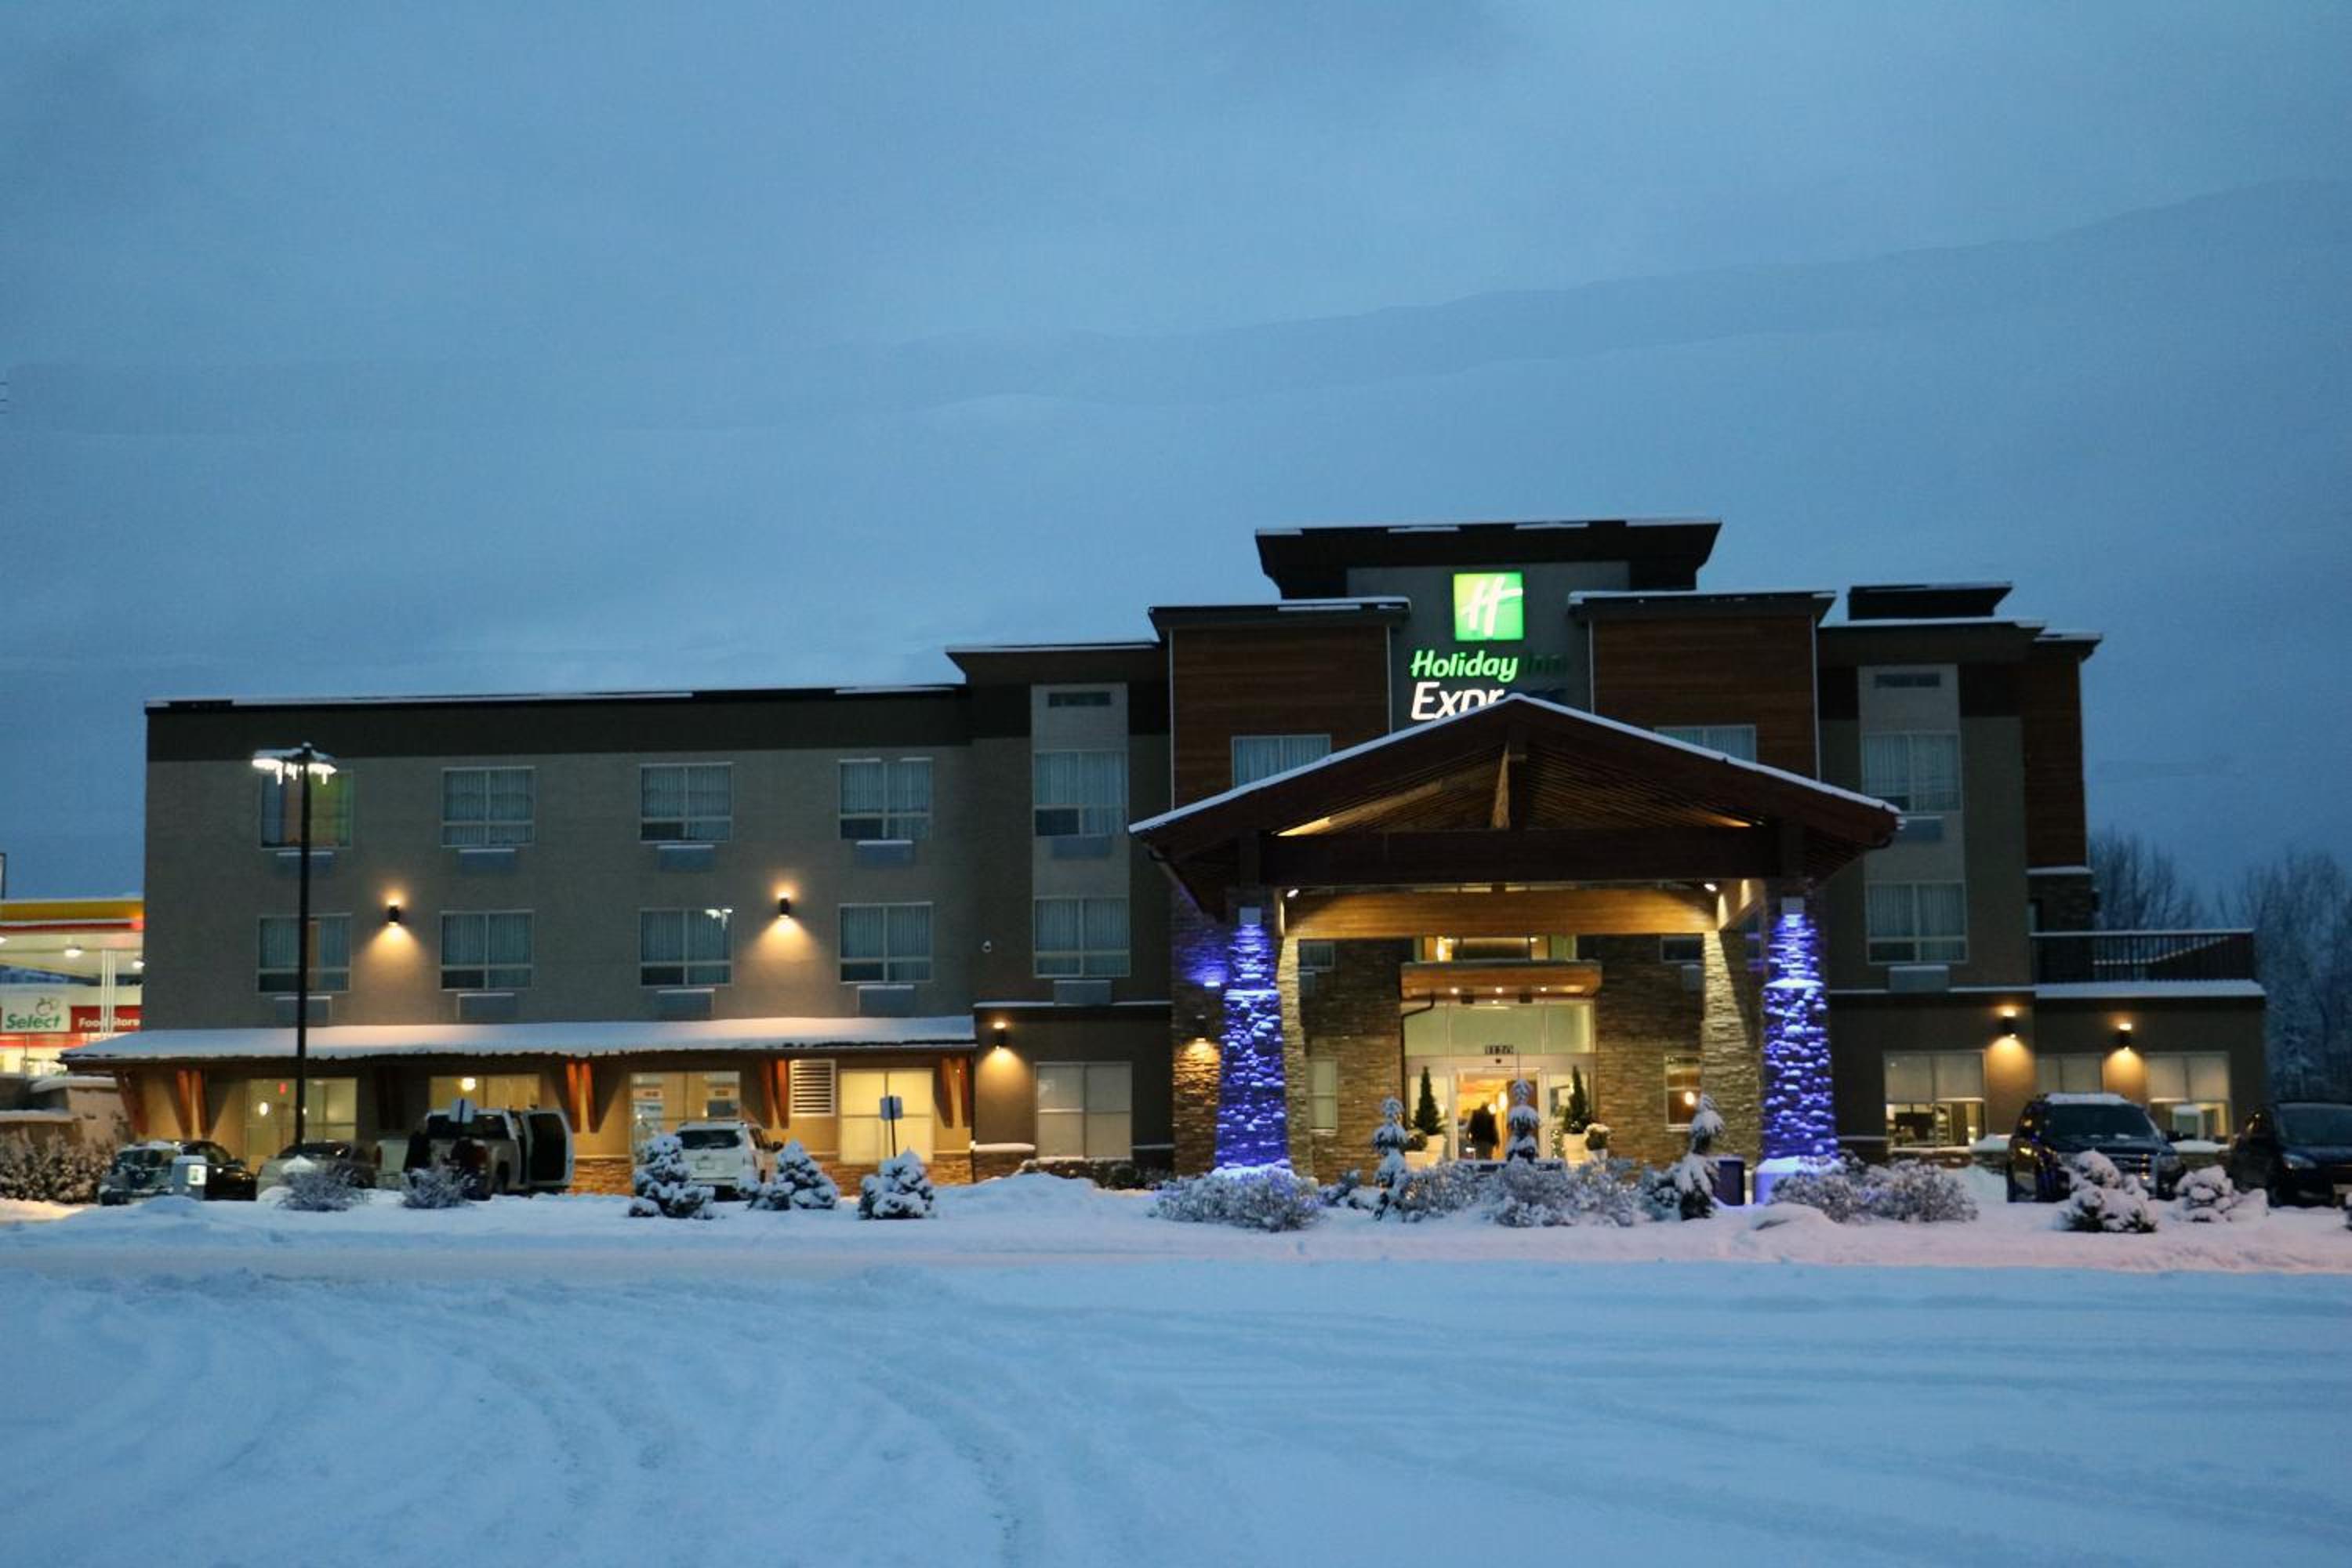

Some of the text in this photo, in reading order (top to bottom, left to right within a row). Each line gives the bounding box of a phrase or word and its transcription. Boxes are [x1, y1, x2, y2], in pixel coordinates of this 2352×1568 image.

[1410, 649, 1519, 683] Holiday
[1410, 681, 1507, 720] Expr
[5, 1013, 61, 1029] Select
